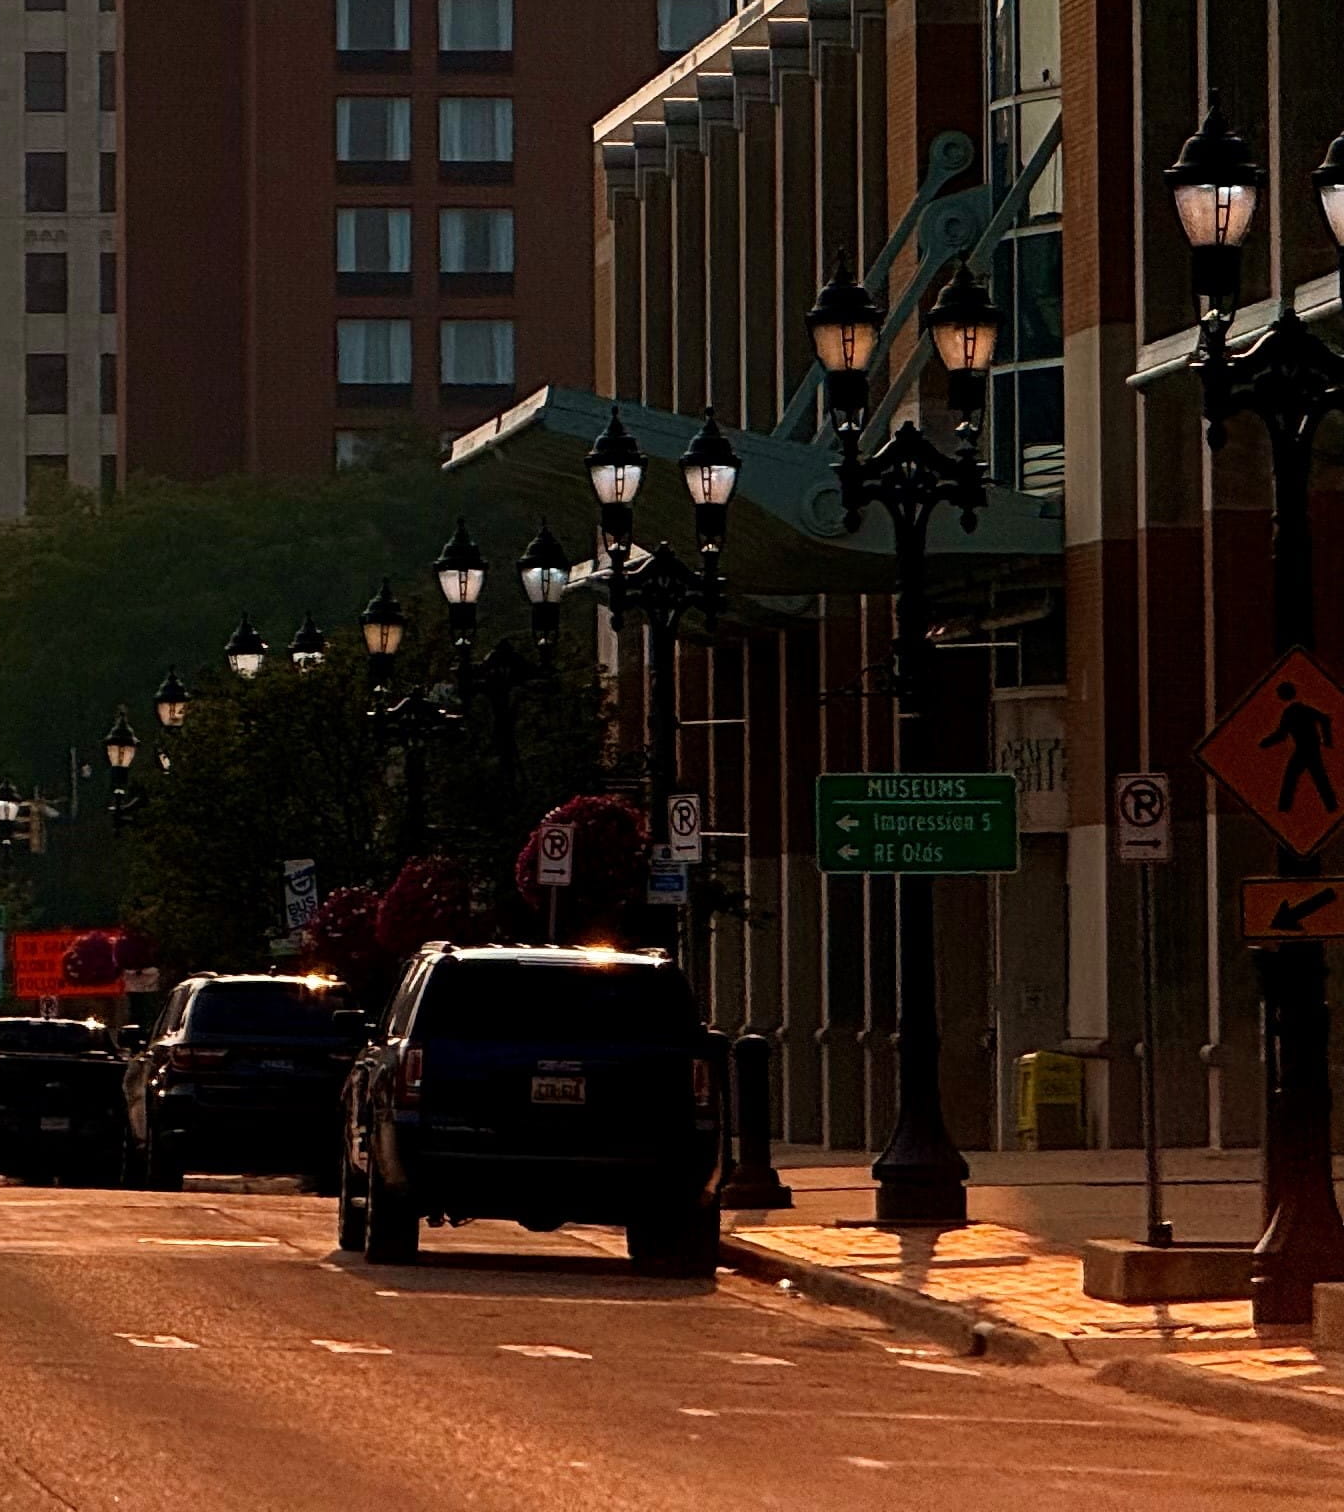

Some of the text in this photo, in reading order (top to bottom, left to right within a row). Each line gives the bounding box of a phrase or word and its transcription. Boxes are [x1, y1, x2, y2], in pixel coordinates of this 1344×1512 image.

[867, 779, 967, 799] MUSEUMS
[873, 811, 974, 836] Impression
[874, 842, 944, 863] RE Olds
